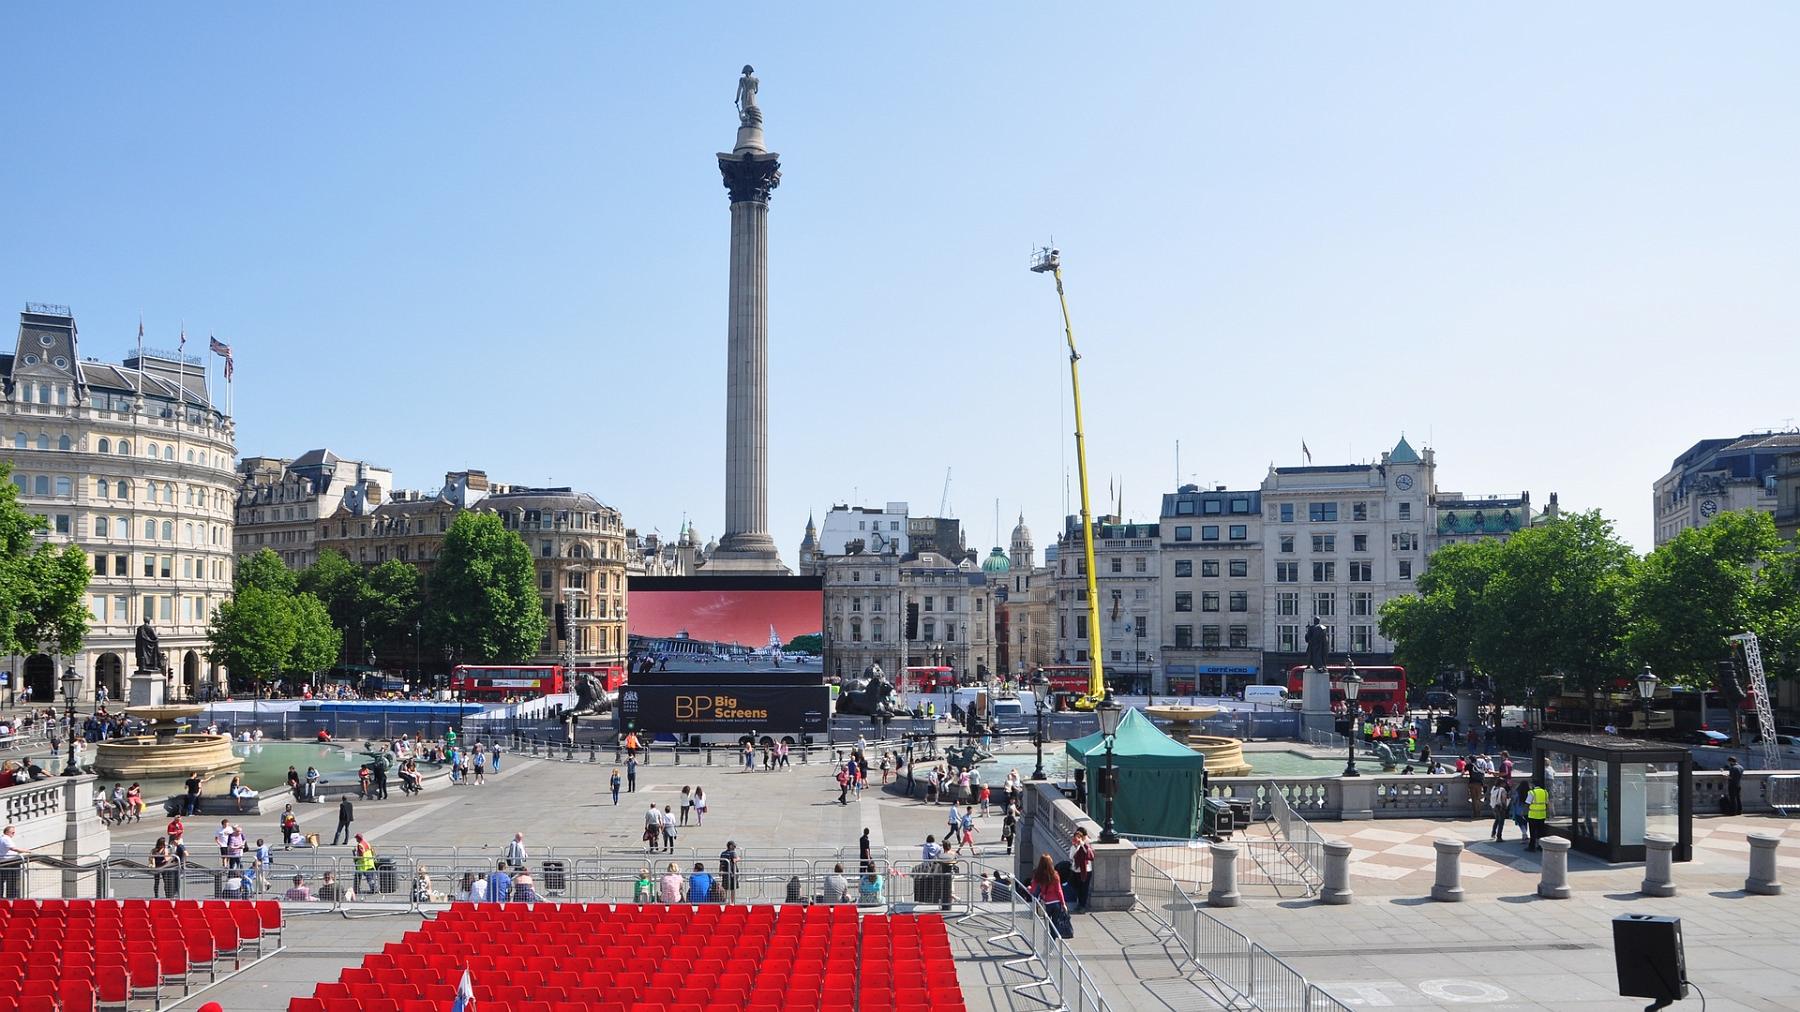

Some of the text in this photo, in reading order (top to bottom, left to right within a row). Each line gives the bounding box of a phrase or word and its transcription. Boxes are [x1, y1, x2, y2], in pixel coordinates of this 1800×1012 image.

[675, 695, 713, 719] BP
[714, 696, 737, 708] Big
[714, 708, 768, 719] Screens
